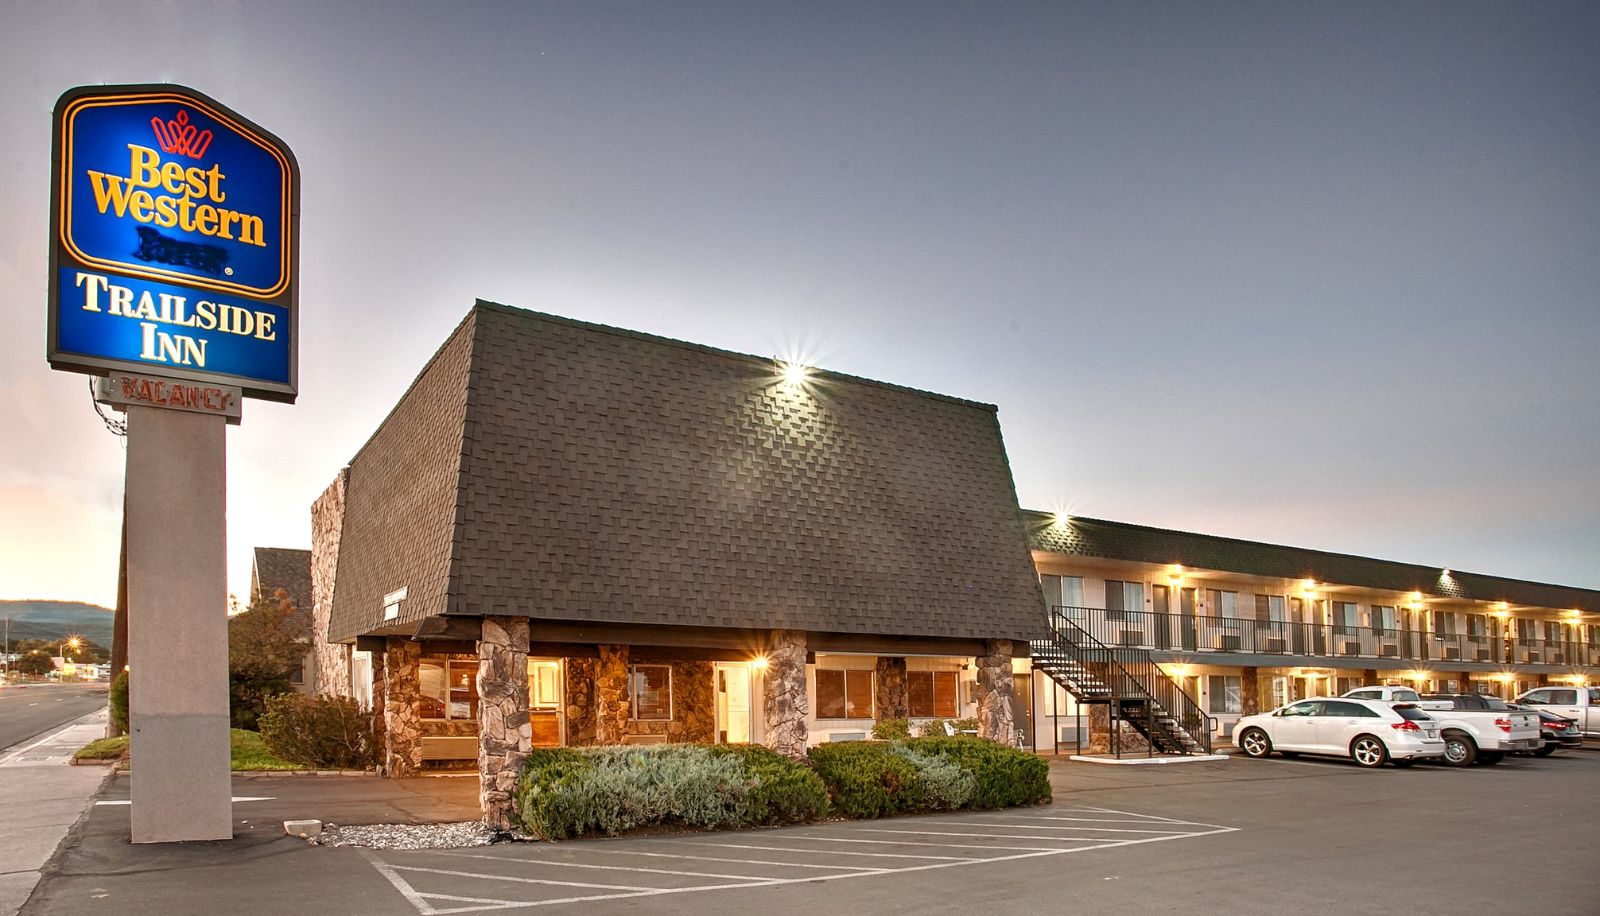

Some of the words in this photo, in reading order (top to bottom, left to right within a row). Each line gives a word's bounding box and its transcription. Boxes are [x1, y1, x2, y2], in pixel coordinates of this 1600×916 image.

[128, 143, 225, 202] Best
[87, 170, 266, 246] Western
[76, 272, 276, 341] TRAILSIDE
[140, 322, 207, 367] INN
[120, 376, 232, 410] VACANCY
